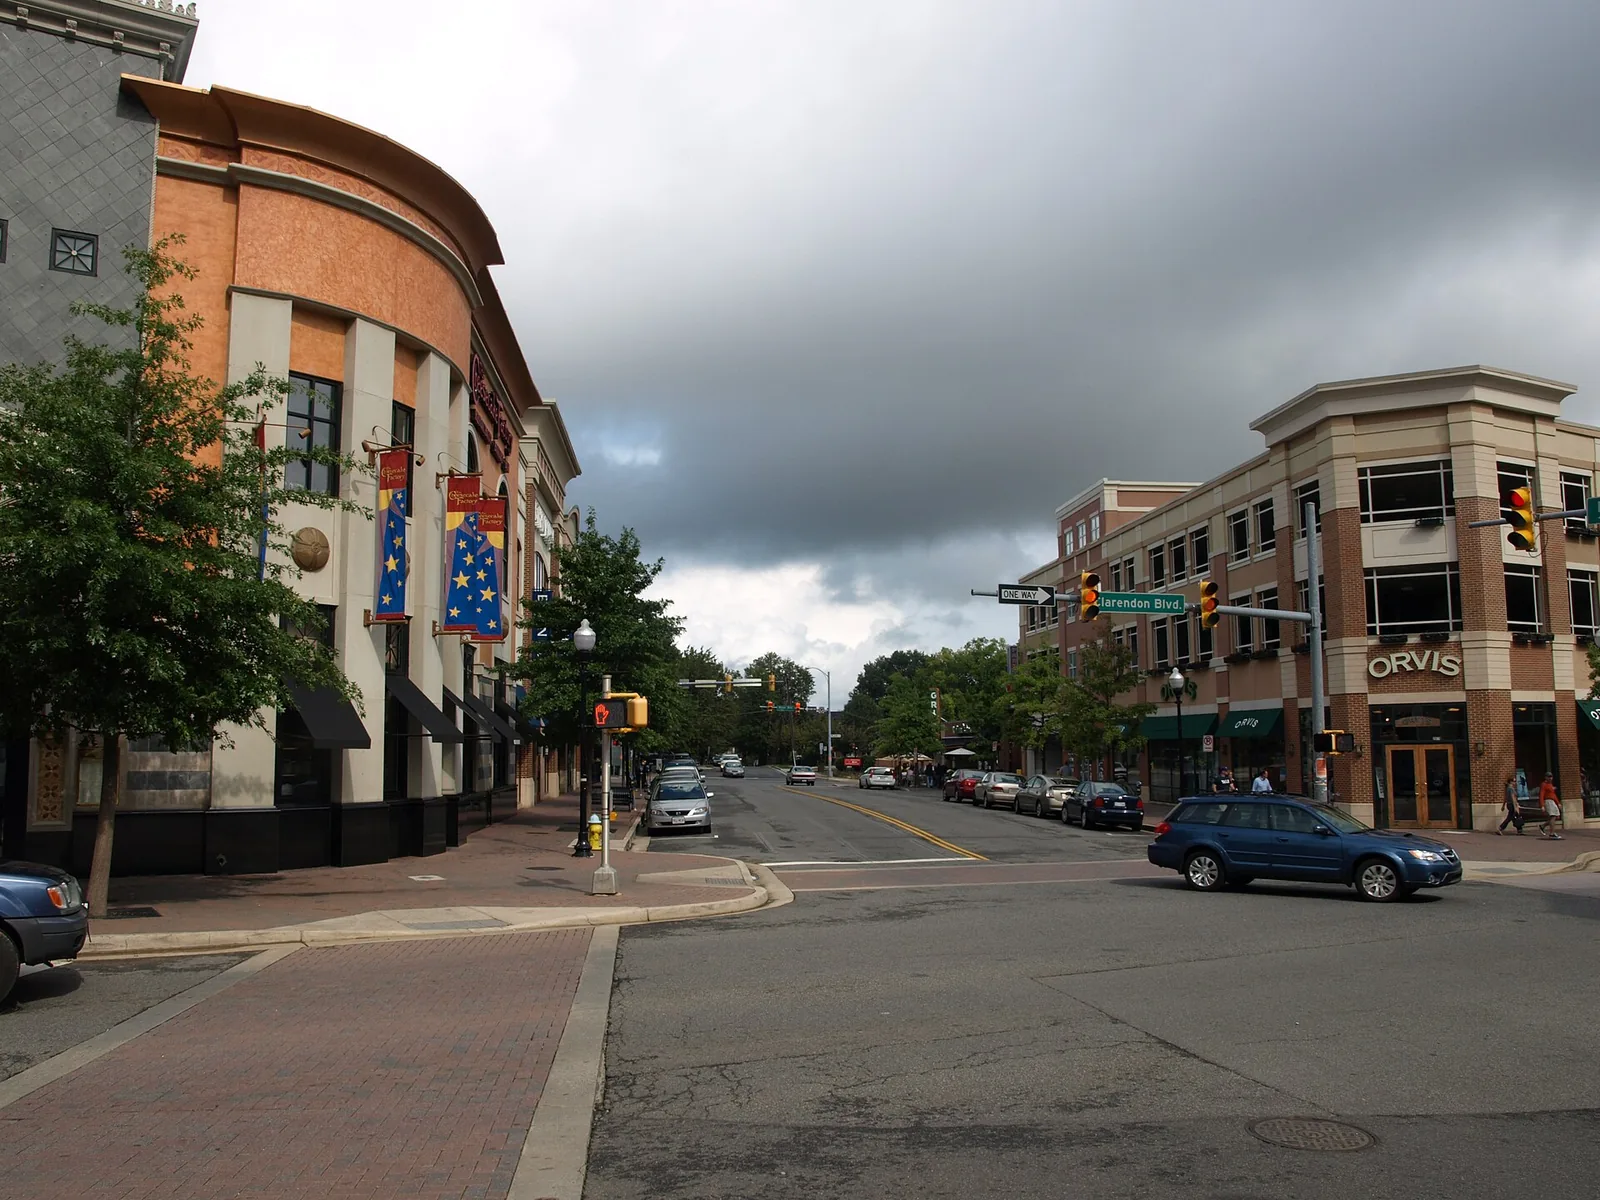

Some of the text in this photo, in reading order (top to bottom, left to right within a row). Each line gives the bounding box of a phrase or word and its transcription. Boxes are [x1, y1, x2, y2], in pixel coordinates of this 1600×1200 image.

[1003, 590, 1037, 599] ONE WAY
[1154, 598, 1182, 610] Blvd.
[1368, 650, 1462, 678] ORVIS
[1234, 717, 1259, 729] ORVIS
